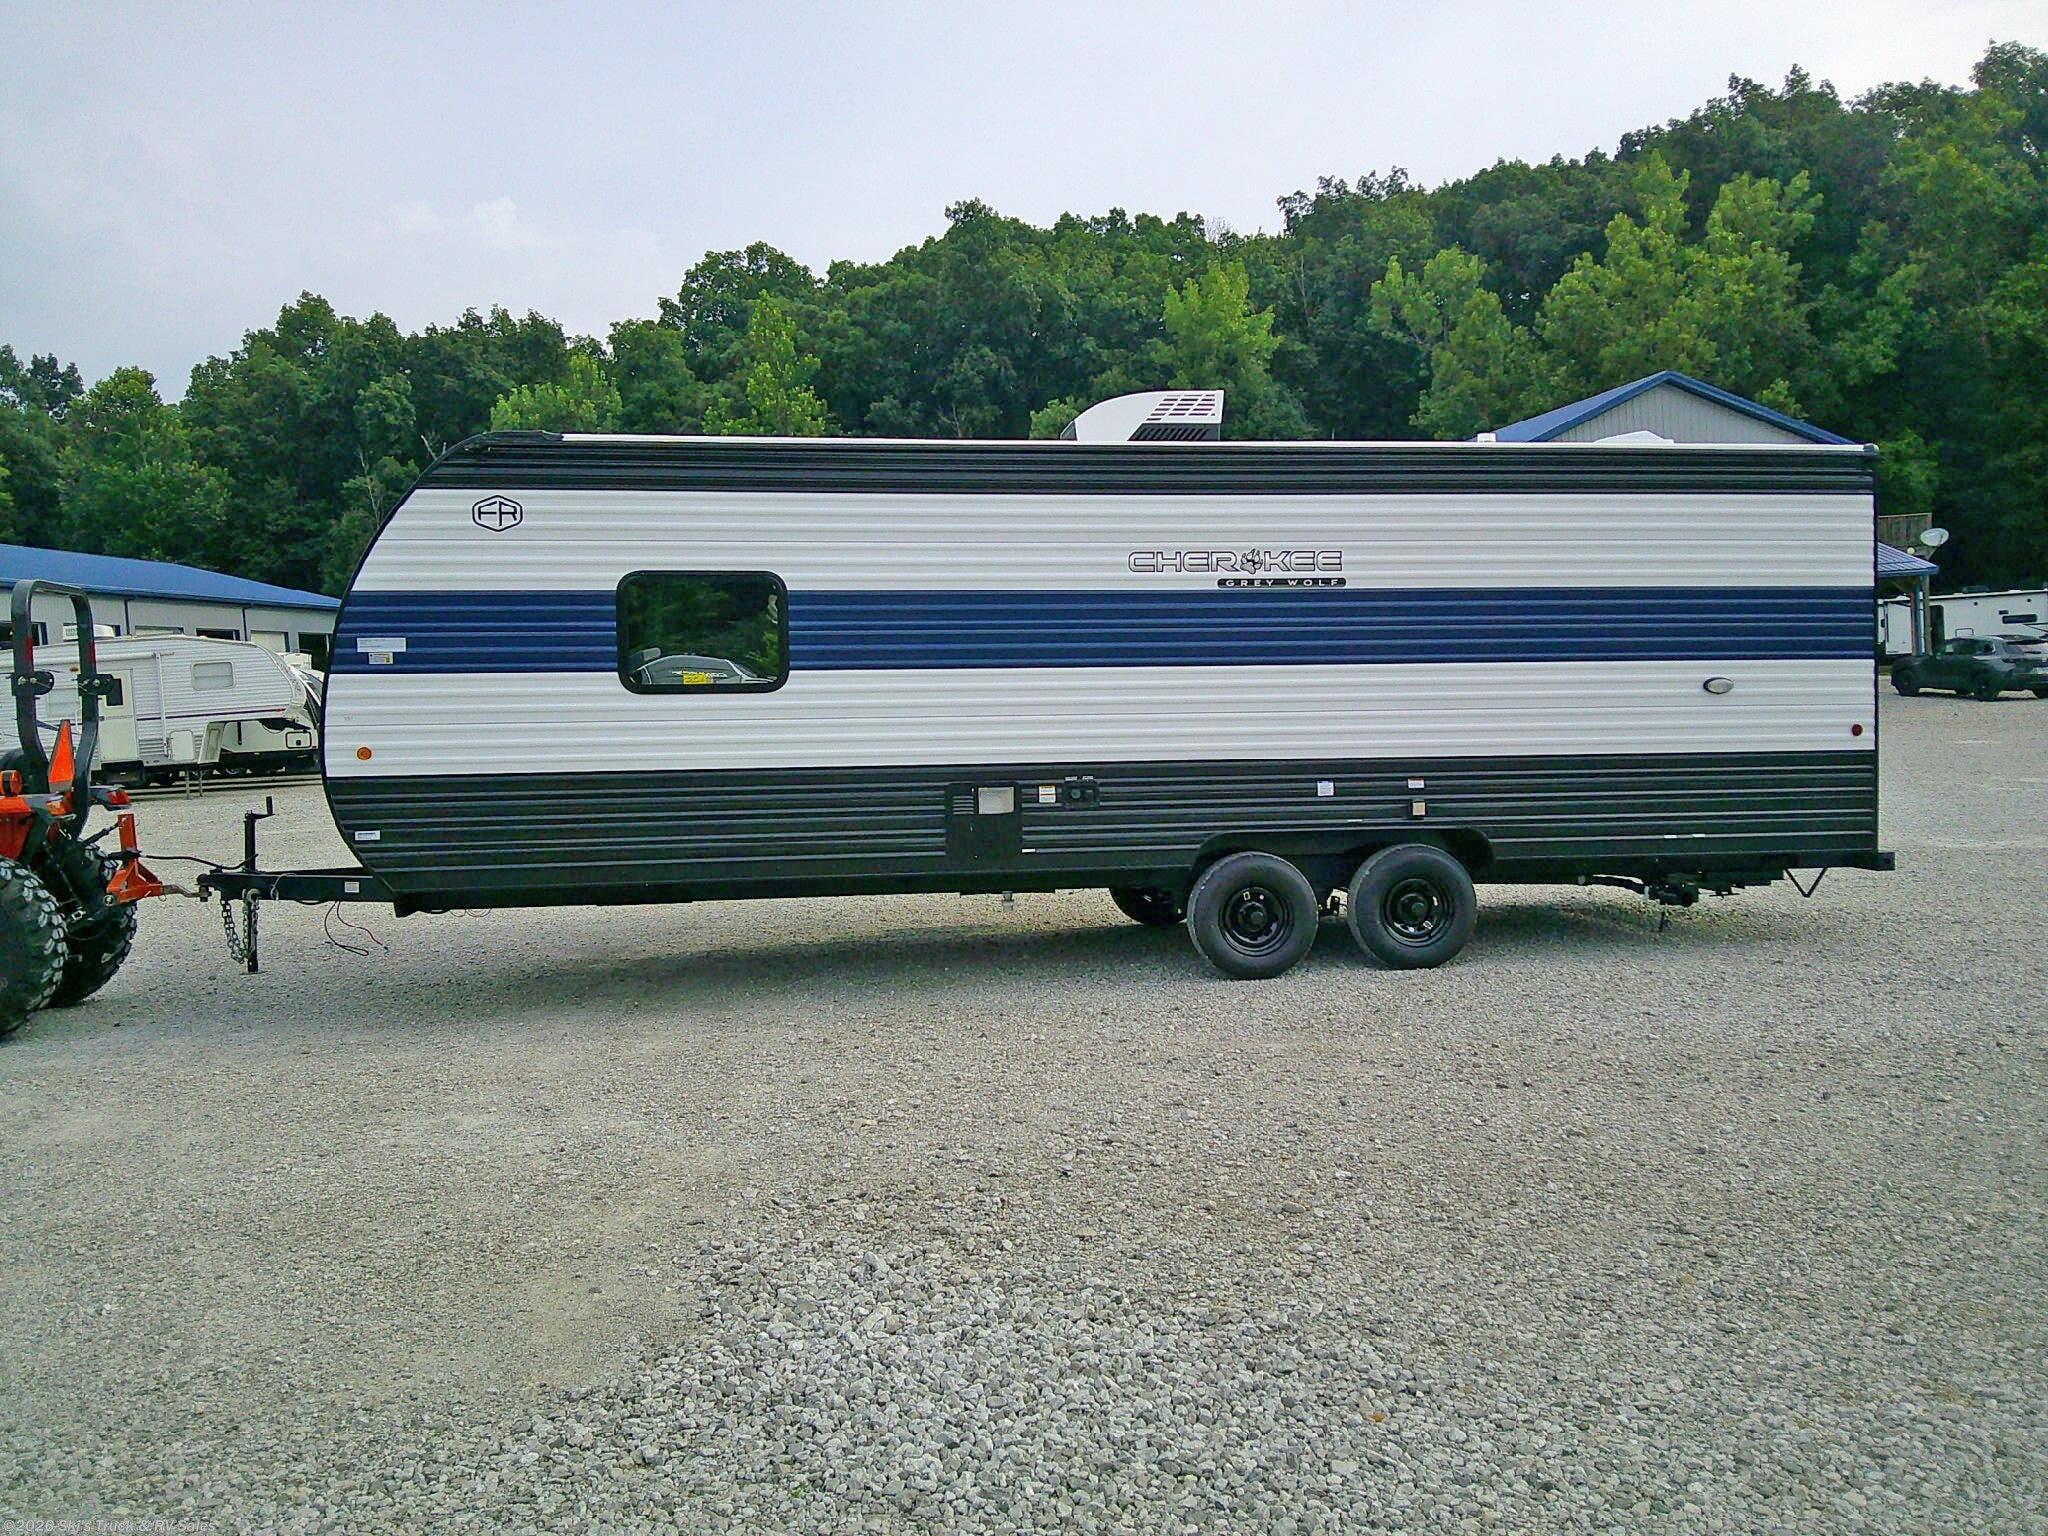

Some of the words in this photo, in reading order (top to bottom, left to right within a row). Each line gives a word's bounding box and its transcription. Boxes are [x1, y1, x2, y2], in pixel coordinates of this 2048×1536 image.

[1128, 549, 1343, 574] CHEROKEE
[1225, 579, 1274, 587] GREY
[1287, 579, 1339, 587] WOLF
